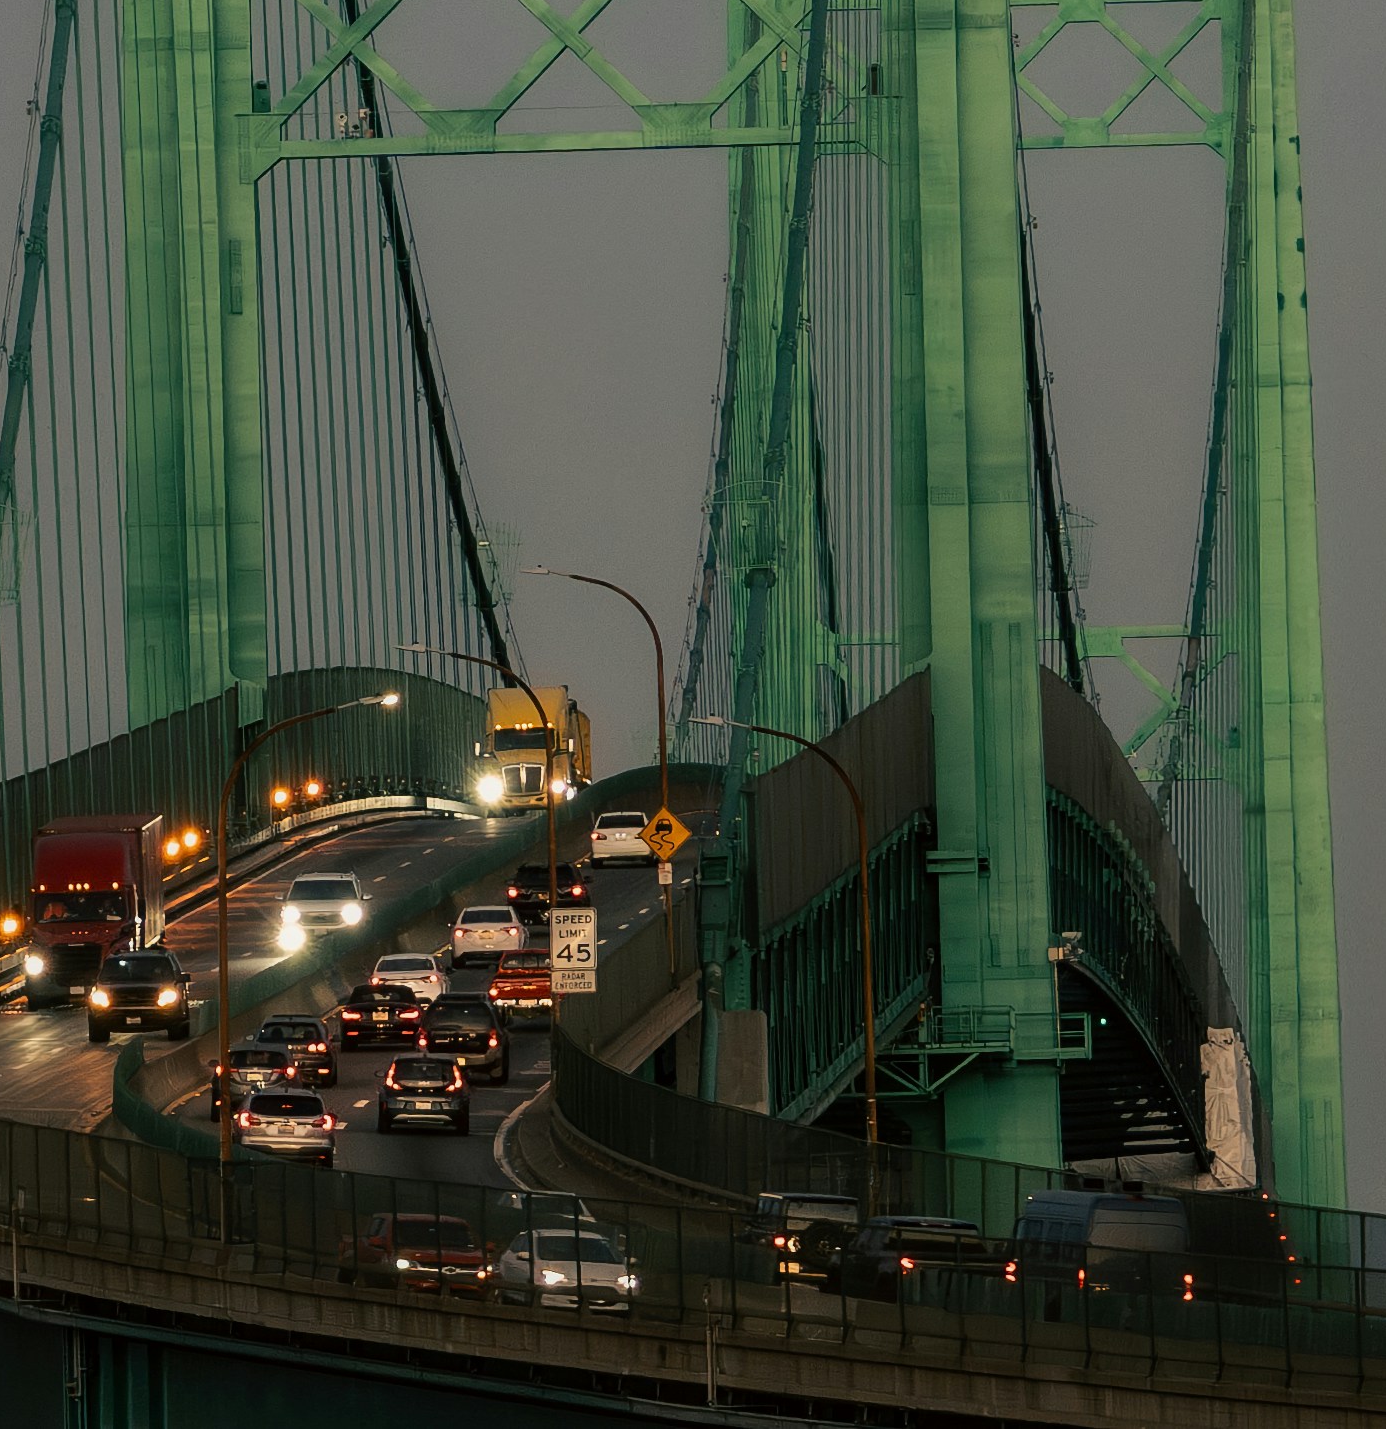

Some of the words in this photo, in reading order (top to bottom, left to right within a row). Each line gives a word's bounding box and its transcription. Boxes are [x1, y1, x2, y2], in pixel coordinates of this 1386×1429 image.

[555, 915, 592, 924] SPEED
[559, 929, 587, 938] LIMIT
[556, 943, 591, 962] 45
[555, 982, 592, 990] ENFORCED
